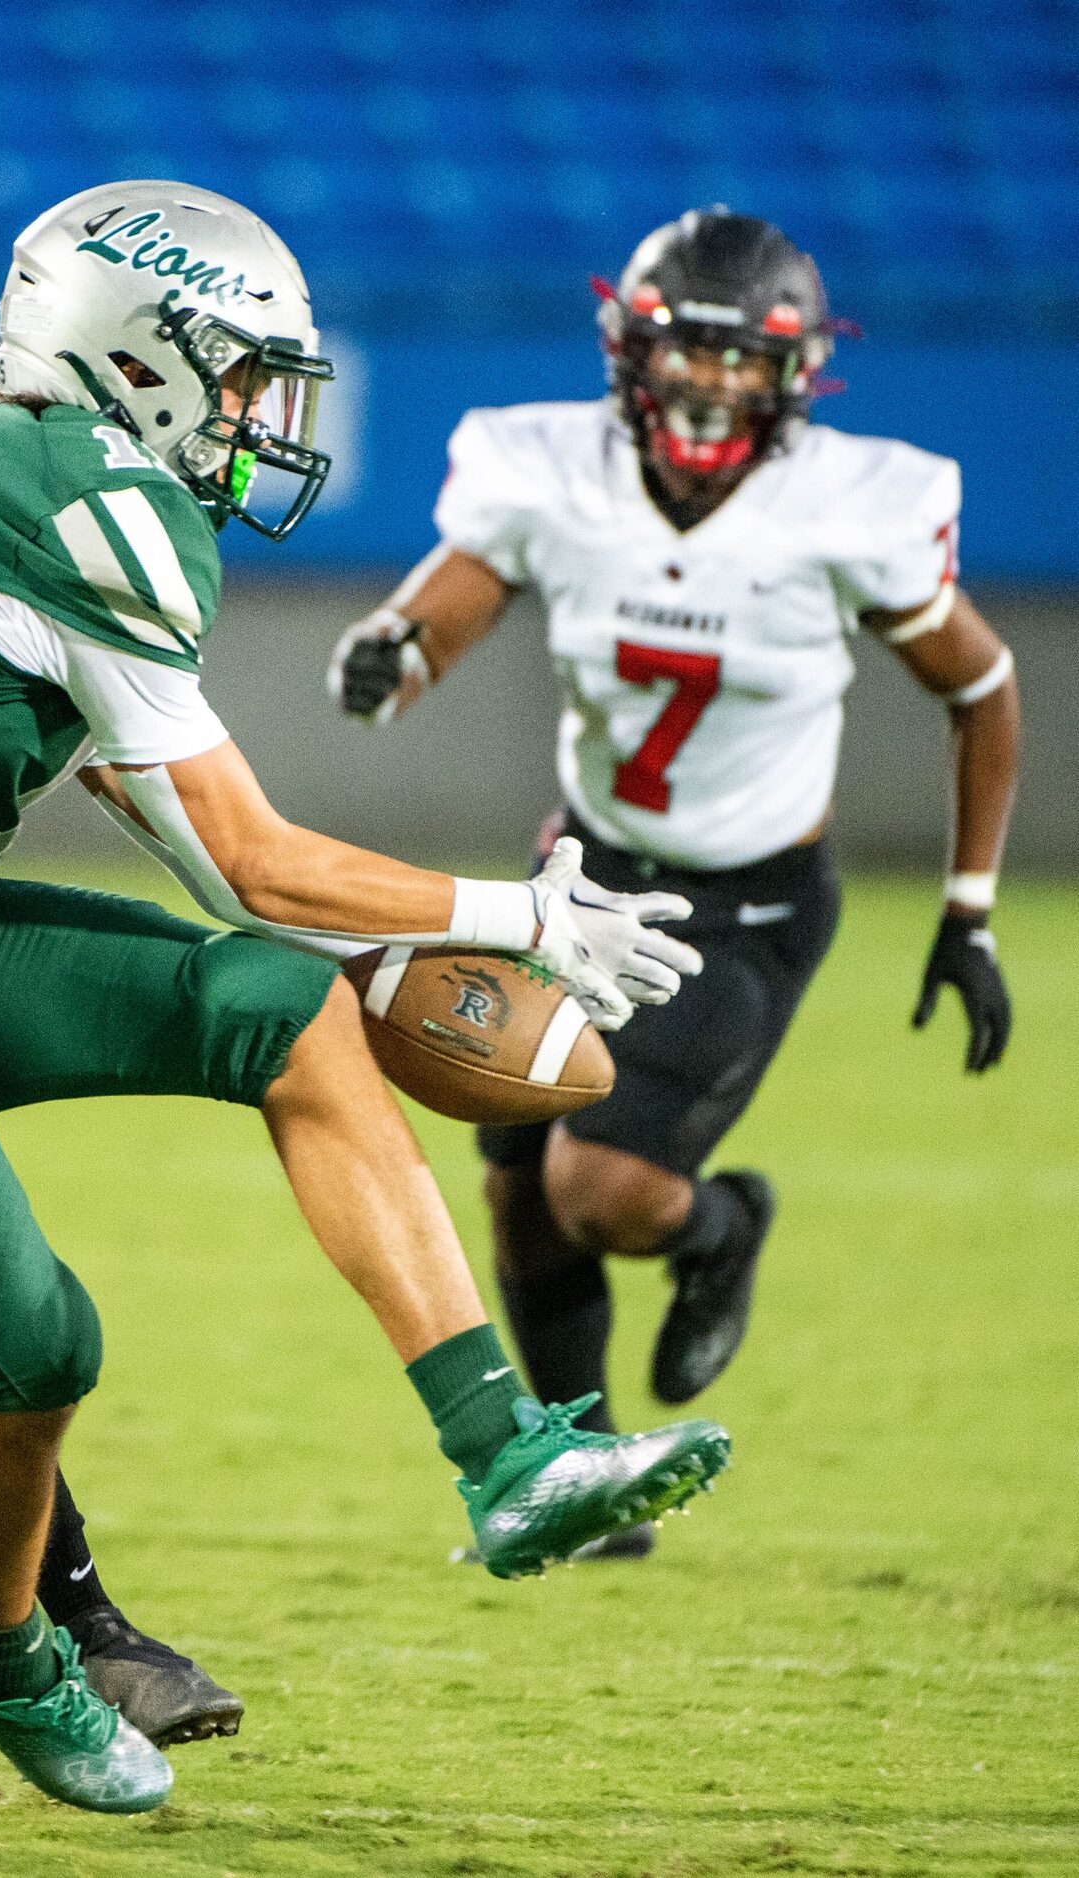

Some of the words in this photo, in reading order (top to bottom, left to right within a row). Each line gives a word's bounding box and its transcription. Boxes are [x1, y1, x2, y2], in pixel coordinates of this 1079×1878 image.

[74, 210, 246, 306] Lions
[613, 639, 721, 815] 7
[451, 987, 493, 1029] R
